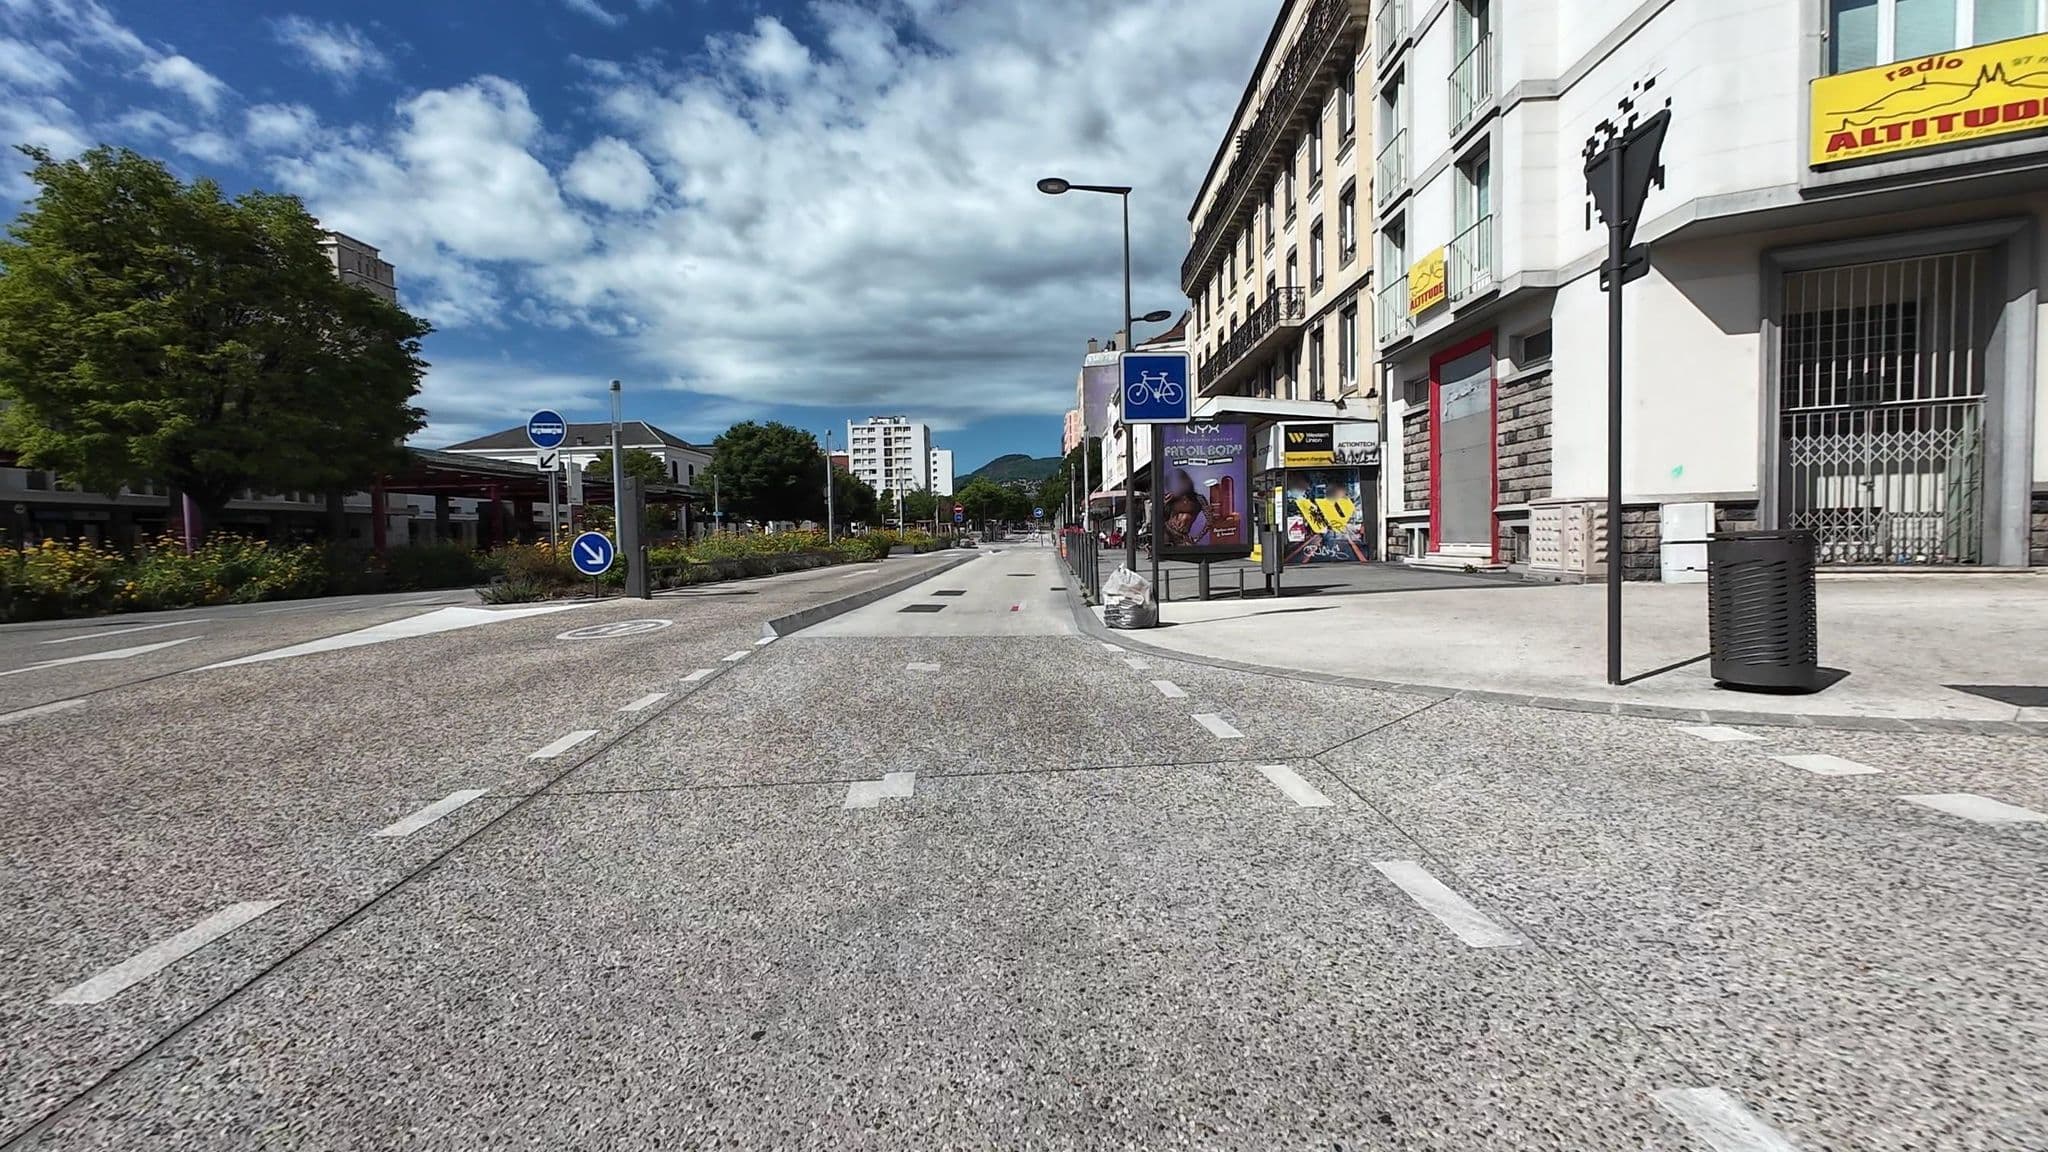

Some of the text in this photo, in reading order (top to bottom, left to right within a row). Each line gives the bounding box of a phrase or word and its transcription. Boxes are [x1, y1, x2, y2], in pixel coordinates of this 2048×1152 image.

[1885, 56, 1963, 82] radio
[1409, 281, 1444, 311] ALTITUDE
[1185, 424, 1220, 435] NYX
[1164, 445, 1185, 457] FAT
[1185, 445, 1205, 456] OIL
